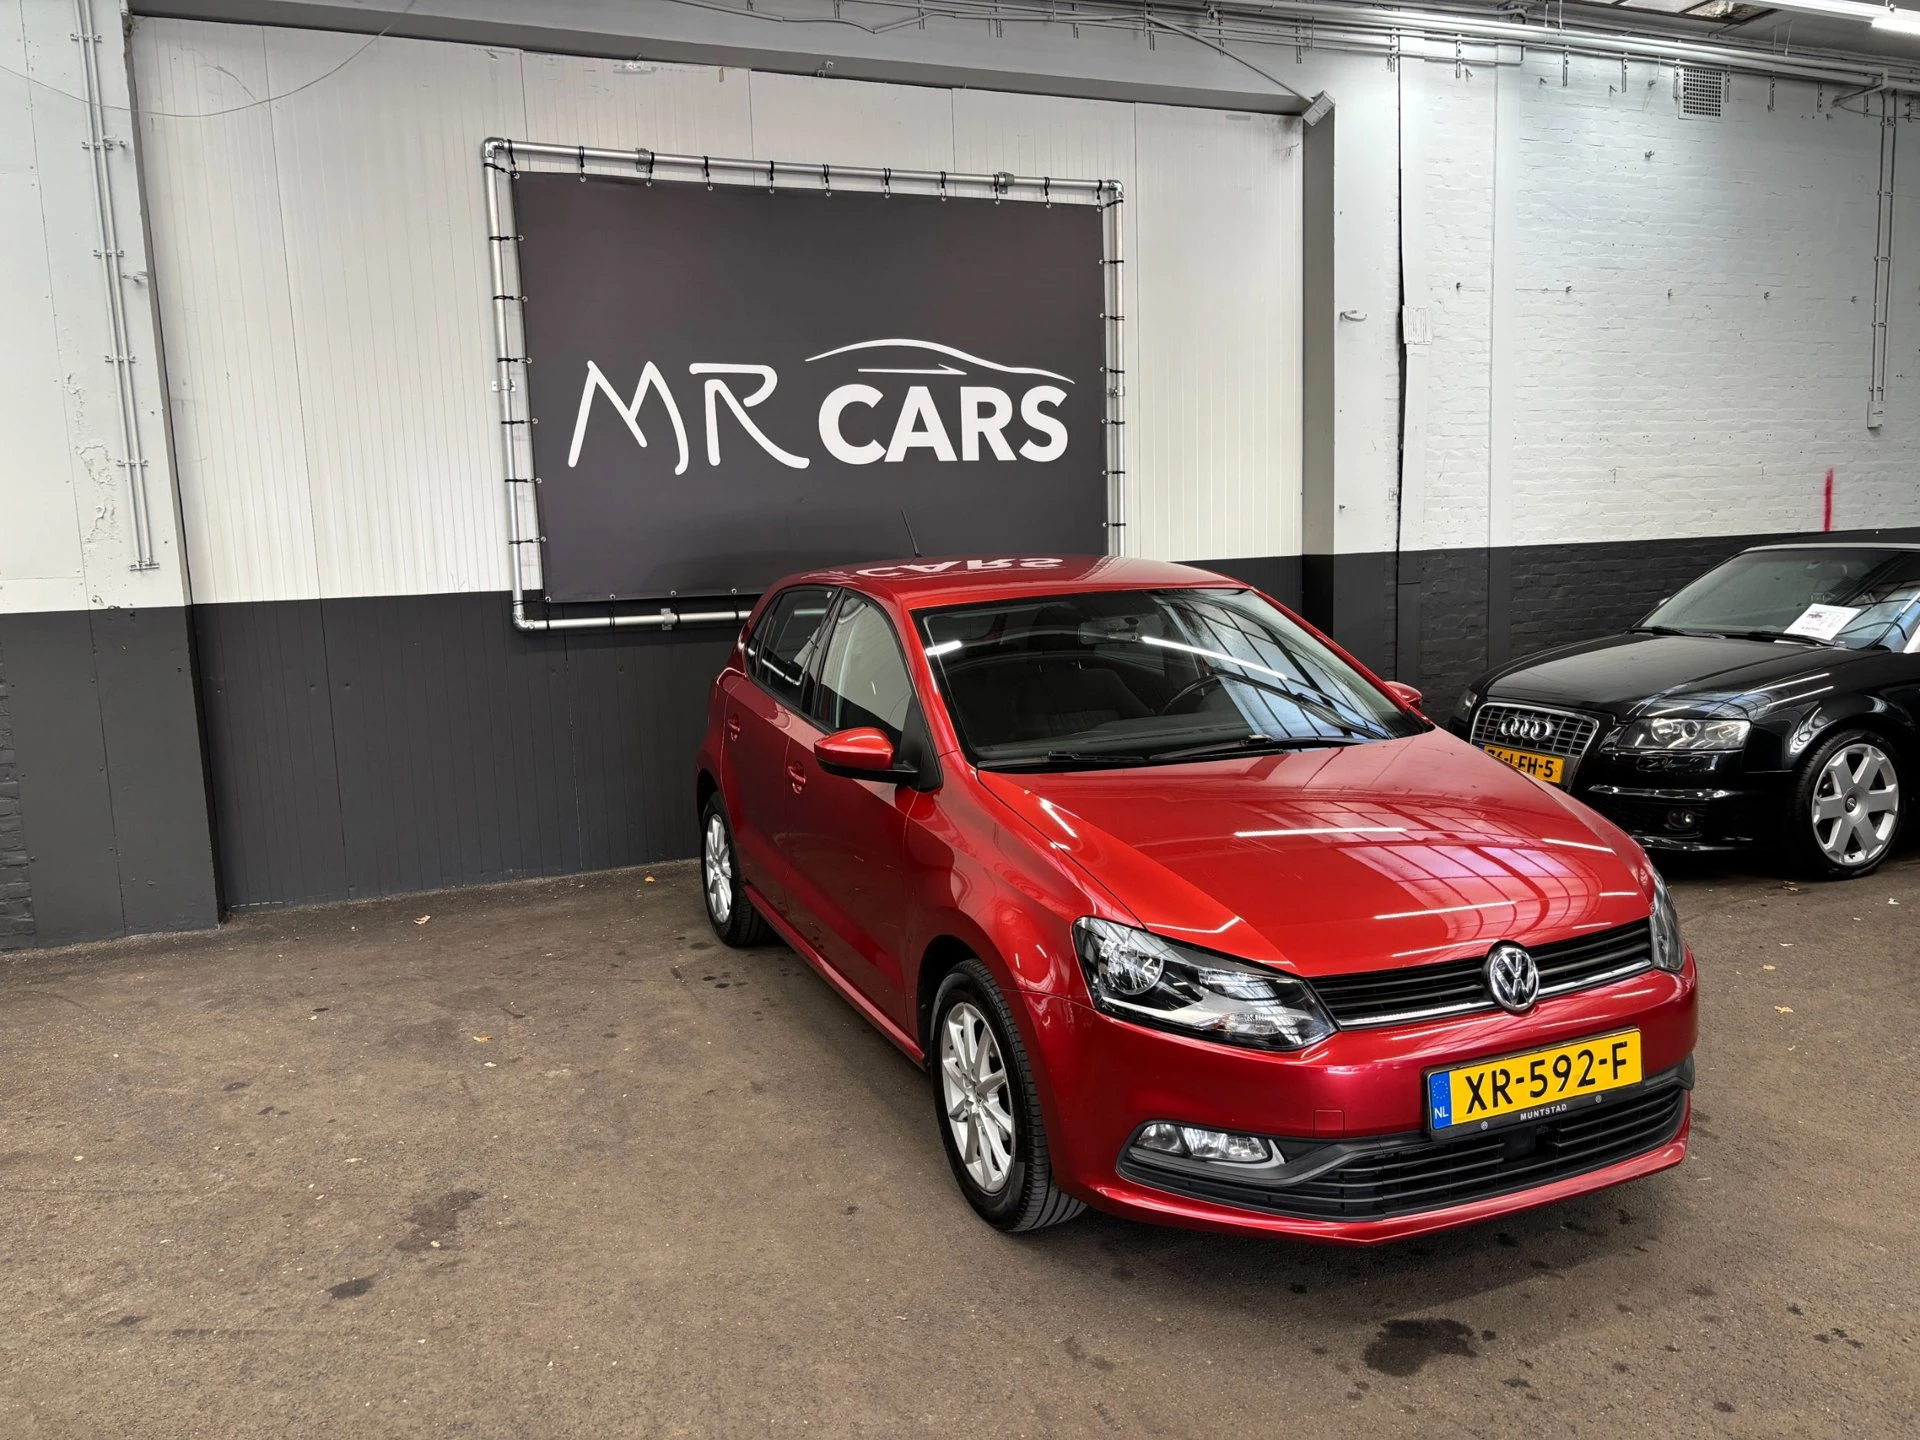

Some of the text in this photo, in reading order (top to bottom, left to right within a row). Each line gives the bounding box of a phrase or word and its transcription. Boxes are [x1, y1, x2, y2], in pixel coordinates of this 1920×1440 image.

[568, 360, 1069, 475] MR CARS
[1466, 1041, 1628, 1115] XR-592-F
[1434, 1106, 1449, 1118] NL
[1520, 1104, 1567, 1121] MUNTSTAD
